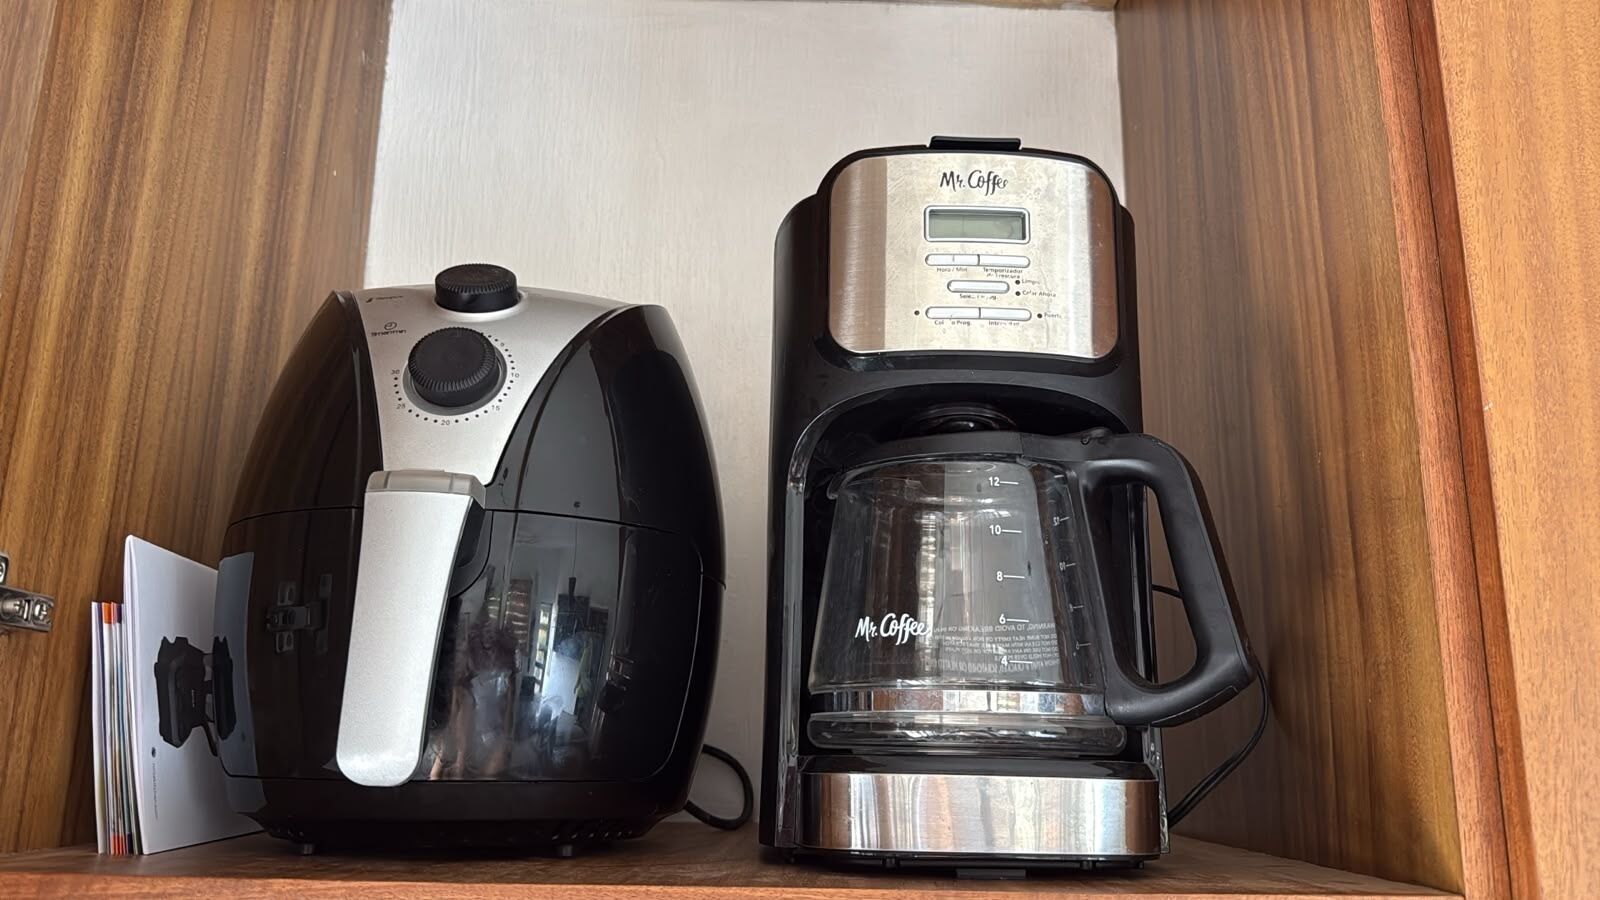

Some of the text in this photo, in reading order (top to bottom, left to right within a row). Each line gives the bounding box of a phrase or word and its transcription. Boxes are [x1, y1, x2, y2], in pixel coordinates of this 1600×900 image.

[940, 169, 1009, 196] Mr. Coffee
[988, 476, 1000, 486] 12
[989, 525, 1001, 535] 10
[996, 571, 1003, 581] 8
[999, 614, 1006, 624] 6
[855, 612, 932, 646] Mr. Coffee
[1001, 656, 1008, 666] 4
